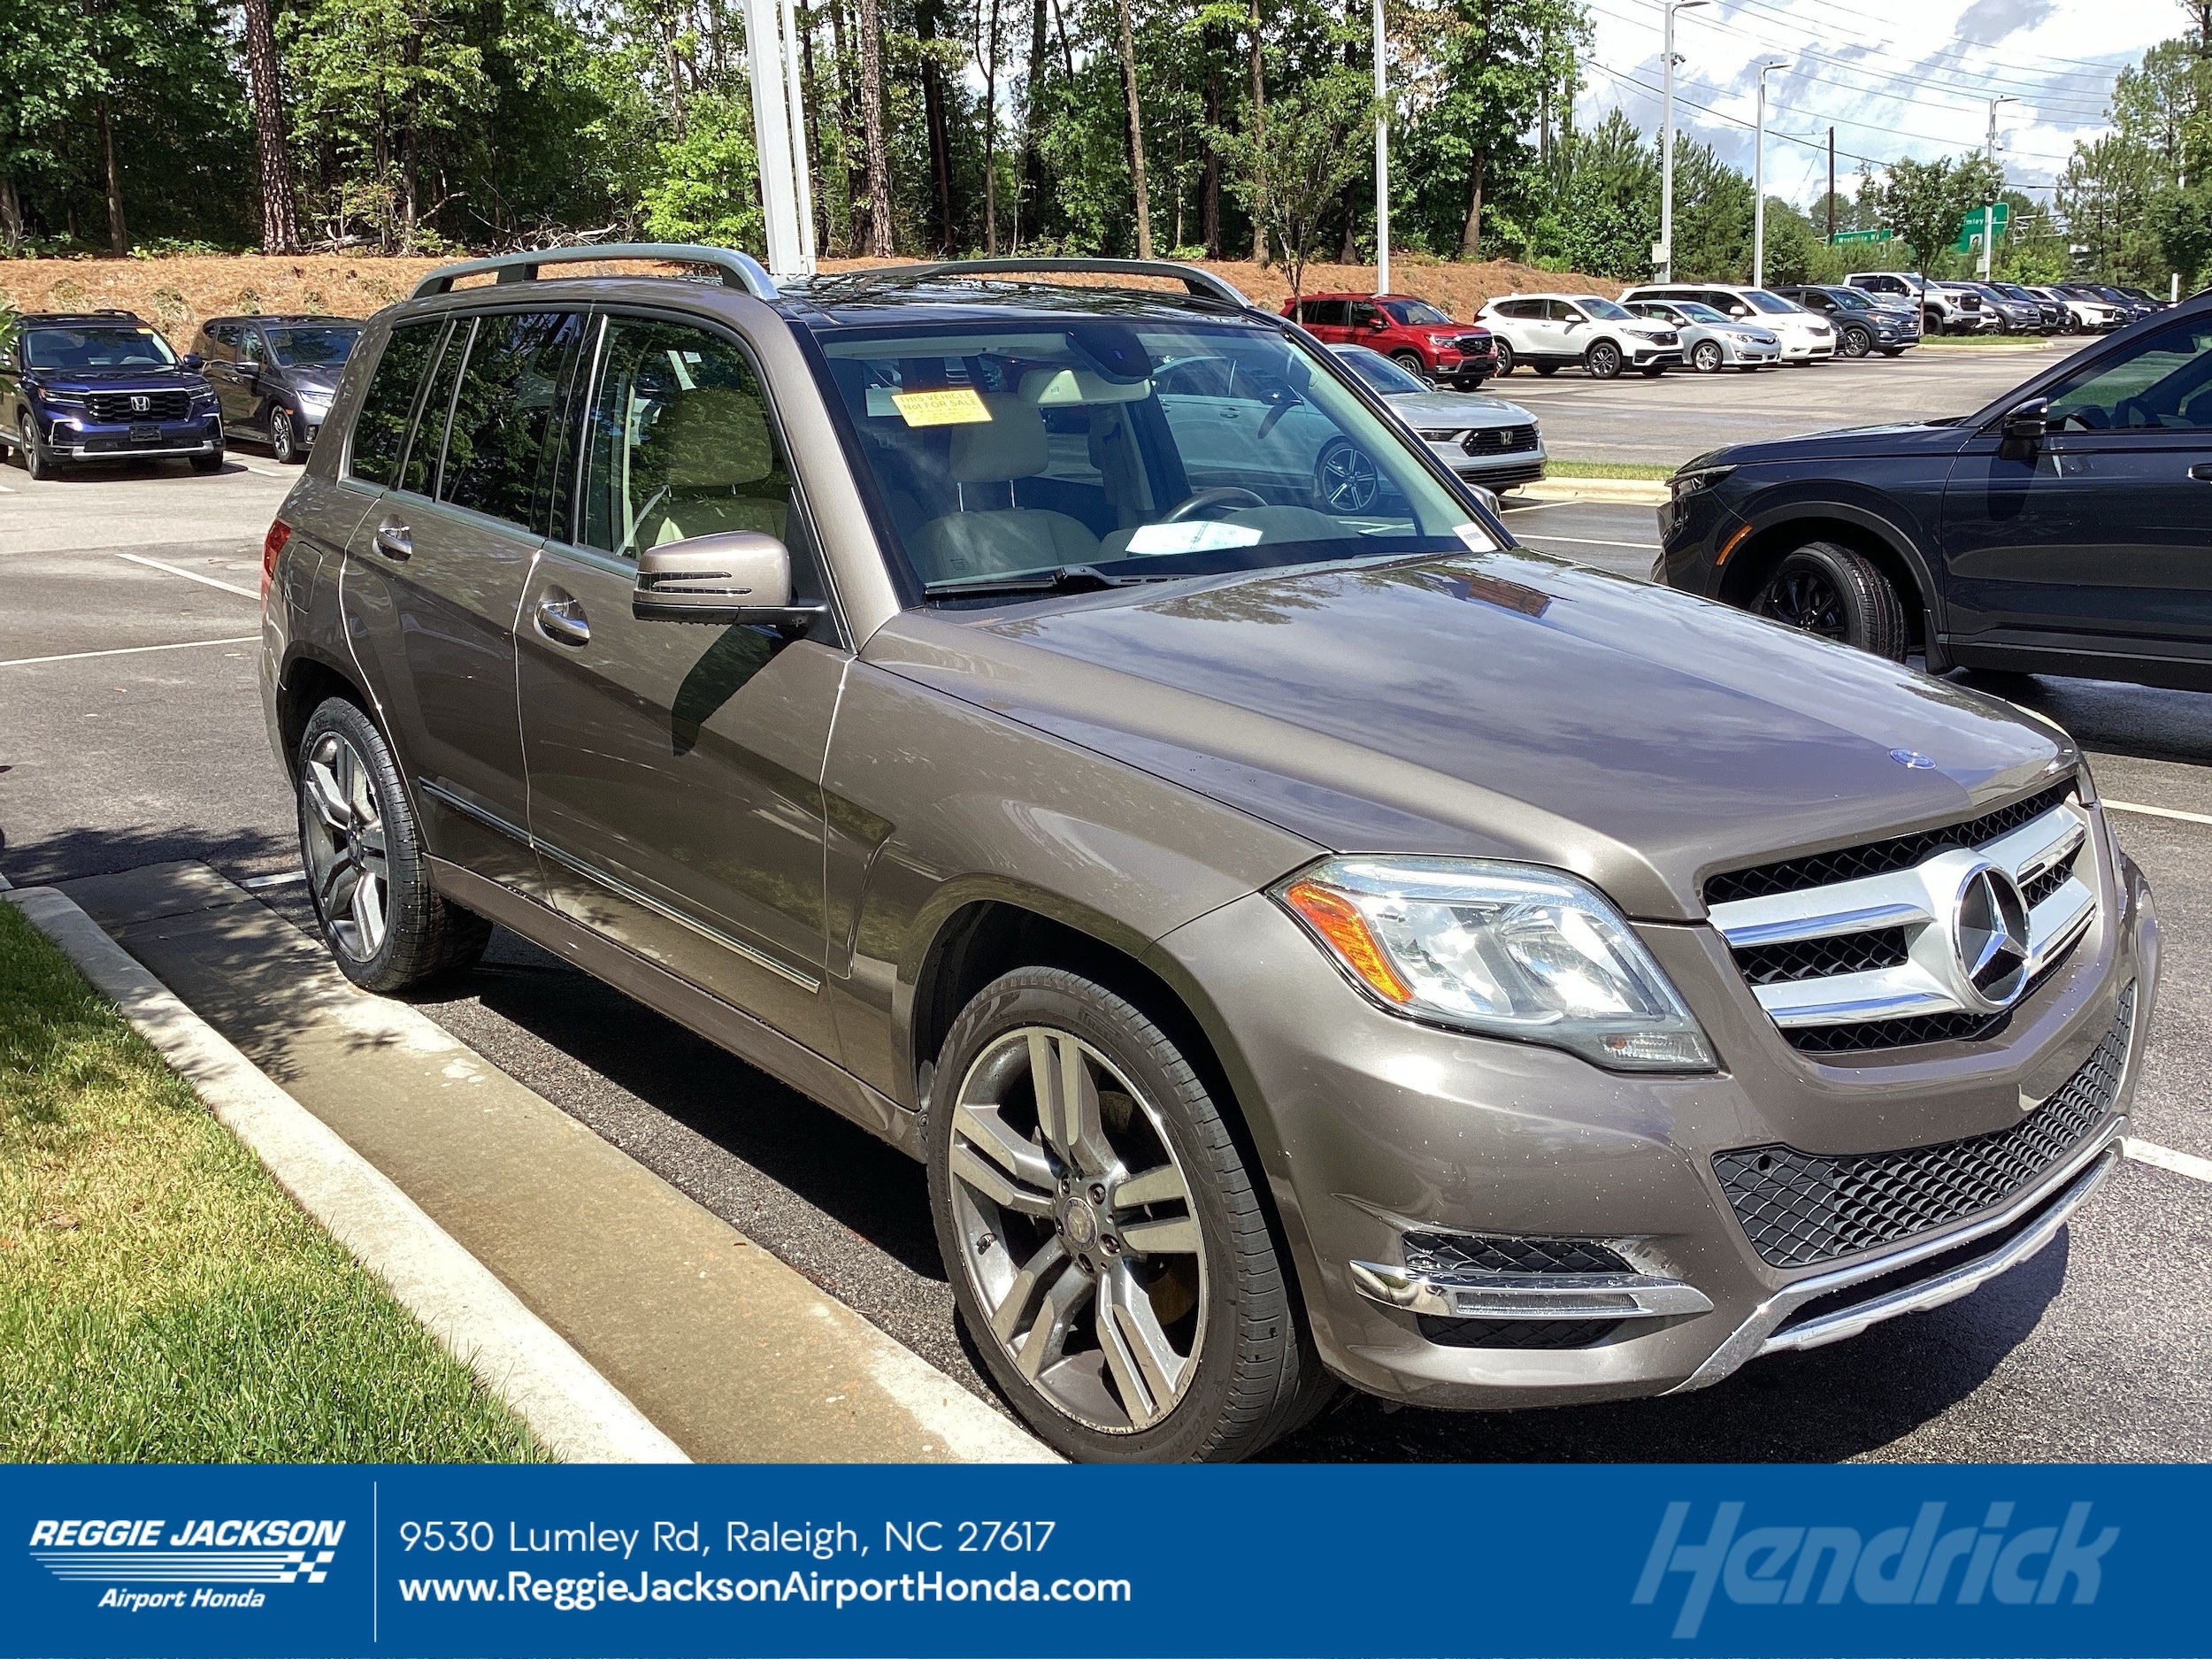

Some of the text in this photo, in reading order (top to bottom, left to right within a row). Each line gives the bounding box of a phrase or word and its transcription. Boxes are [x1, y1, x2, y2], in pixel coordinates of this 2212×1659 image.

[899, 391, 973, 403] THIS VEHICLE
[924, 400, 948, 410] FOR
[949, 398, 979, 408] SALE
